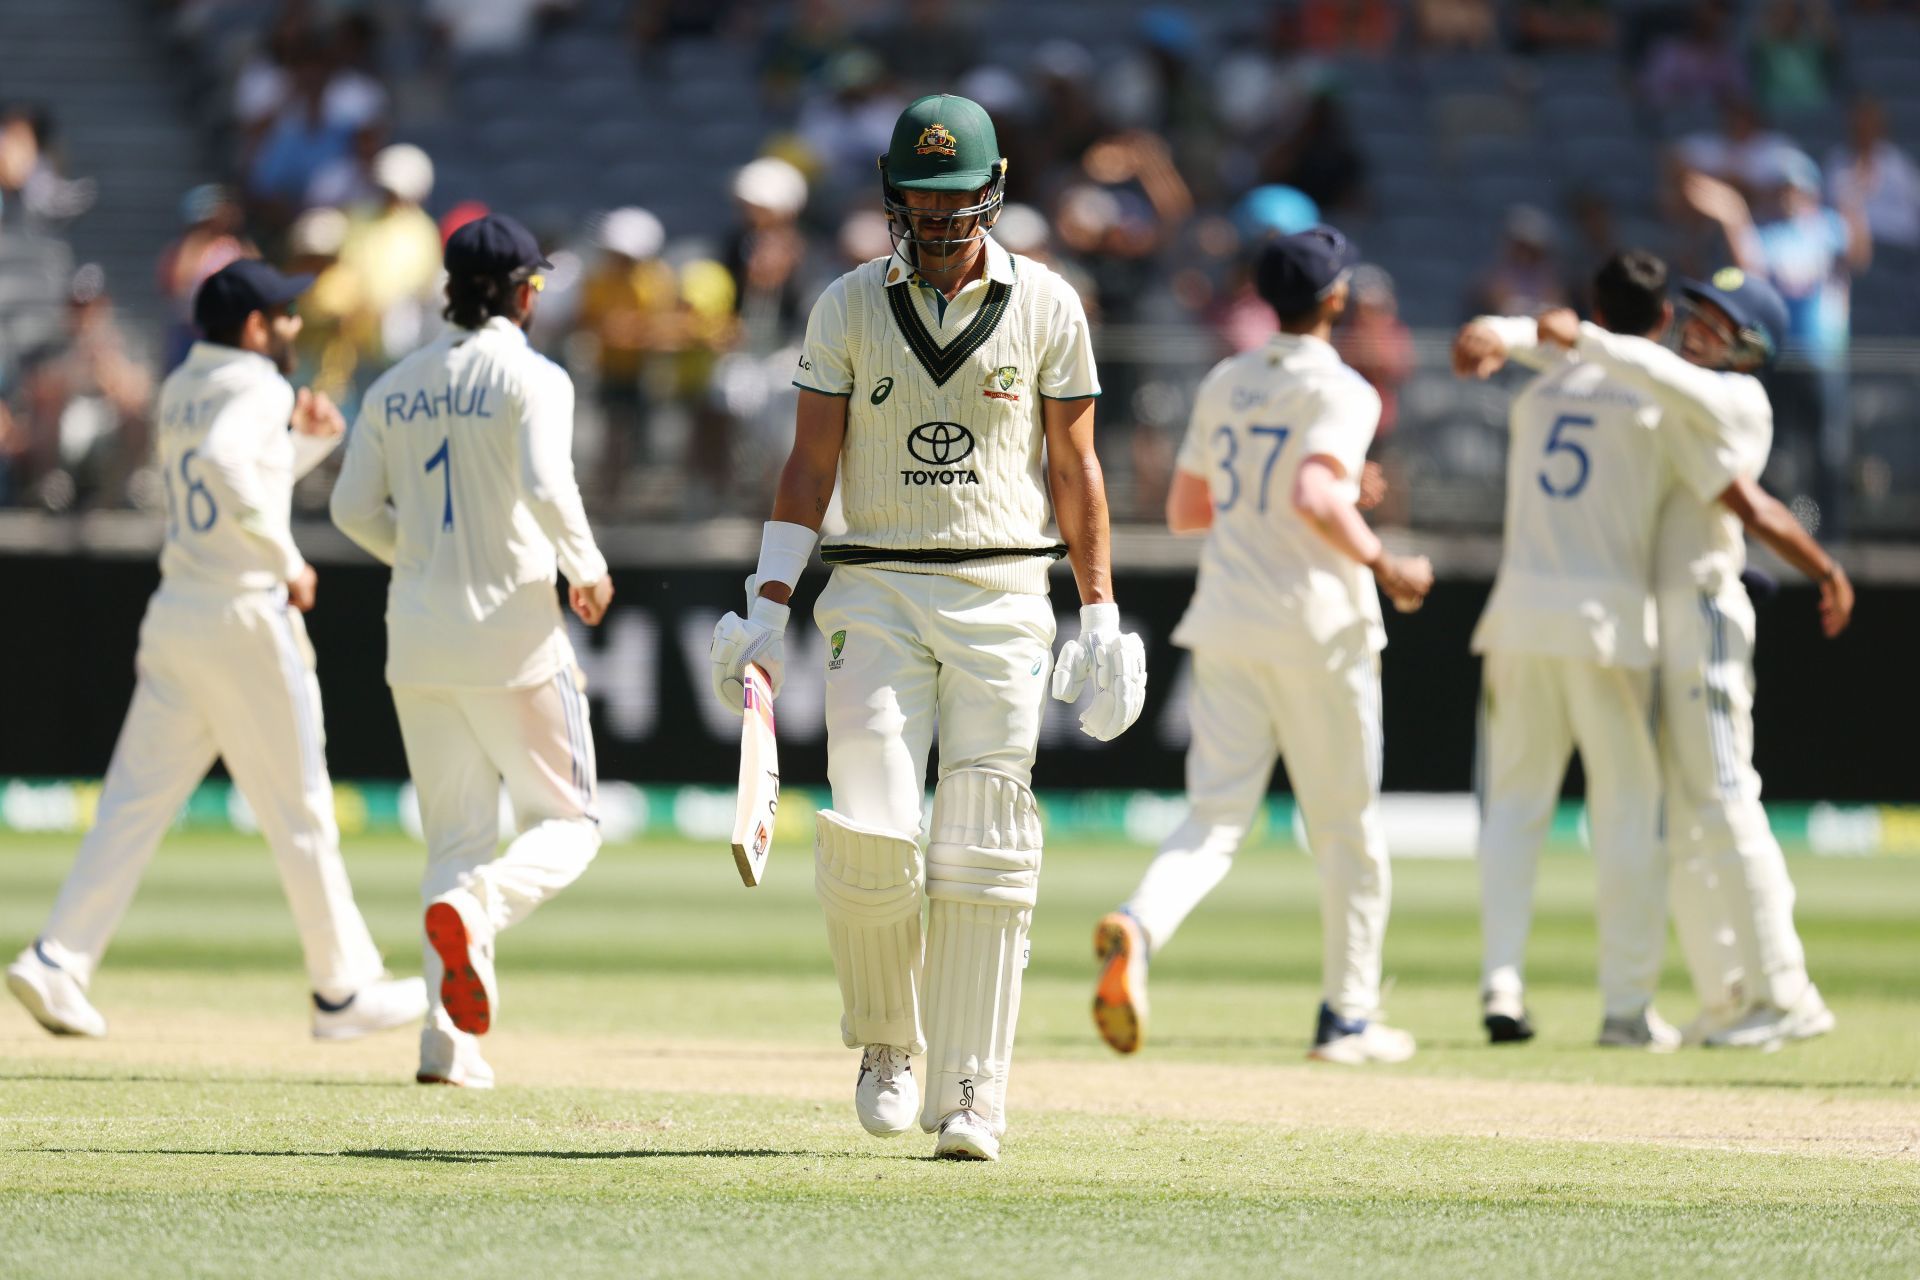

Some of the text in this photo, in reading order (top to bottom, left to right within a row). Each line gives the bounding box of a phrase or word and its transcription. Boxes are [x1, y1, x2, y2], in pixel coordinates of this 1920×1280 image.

[385, 385, 493, 427] RAHUL
[164, 448, 218, 540] 18
[424, 435, 454, 534] 1
[900, 470, 980, 486] TOYOTA
[1210, 425, 1290, 514] 37
[1538, 413, 1595, 498] 5
